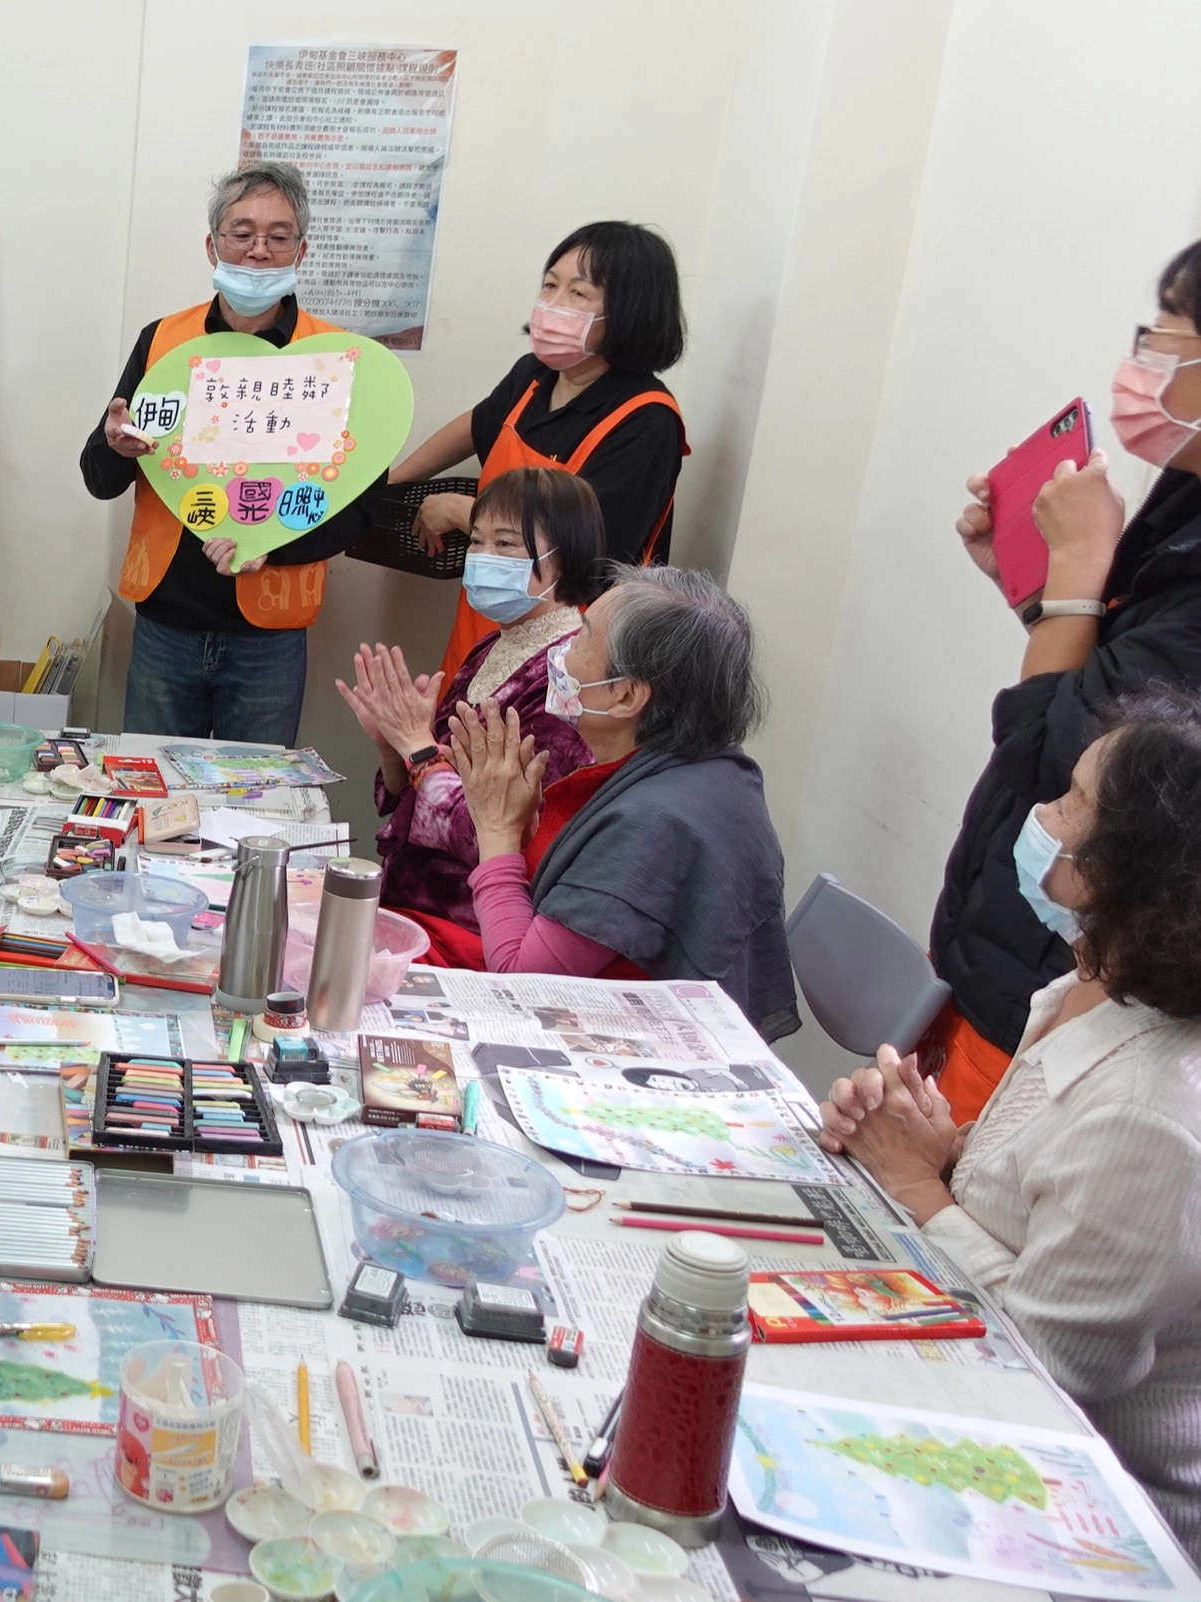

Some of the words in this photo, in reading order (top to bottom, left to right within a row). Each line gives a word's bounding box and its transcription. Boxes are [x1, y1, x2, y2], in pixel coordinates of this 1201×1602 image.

[298, 51, 407, 62] 伊甸基金會三峽服務中心
[205, 375, 331, 402] 敦親睦鄰
[135, 397, 181, 432] 伊甸
[232, 410, 292, 435] 活動
[186, 491, 216, 527] 三峽
[237, 481, 273, 522] 國光
